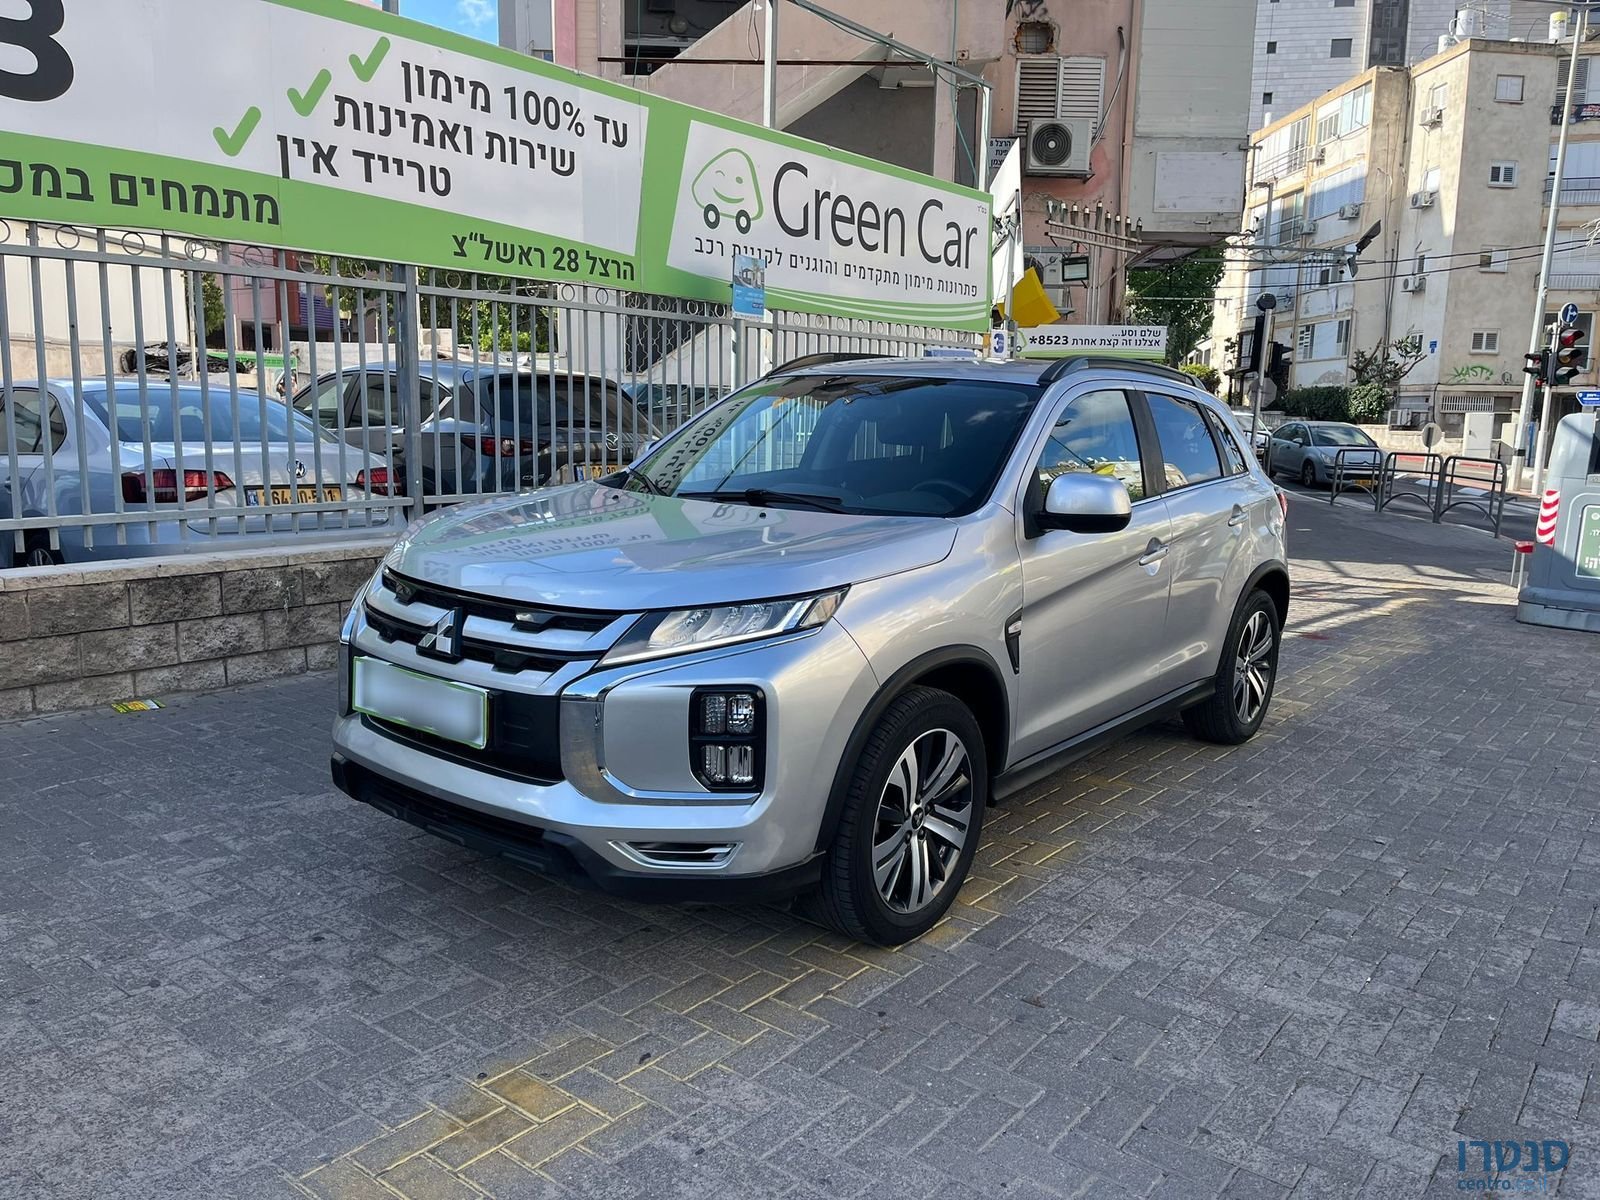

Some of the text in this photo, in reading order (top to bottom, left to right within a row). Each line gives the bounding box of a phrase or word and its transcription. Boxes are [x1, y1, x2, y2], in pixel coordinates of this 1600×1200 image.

[401, 61, 628, 148] עד 100% מימון
[333, 94, 576, 177] שירות ואמינות
[277, 134, 451, 197] טרייד אין
[109, 173, 280, 225] מתמחים
[773, 161, 978, 269] Green Car
[452, 232, 635, 281] הרצל 28 ראשל"צ
[694, 237, 724, 256] רכב
[790, 254, 837, 275] והוגנים
[843, 264, 900, 286] מתקדמים
[905, 274, 933, 291] מימון
[937, 279, 978, 297] פתרונות
[1072, 338, 1097, 346] אחרת
[1099, 338, 1119, 348] קצת
[1135, 338, 1160, 346] אצלנו
[1141, 329, 1161, 337] שלם
